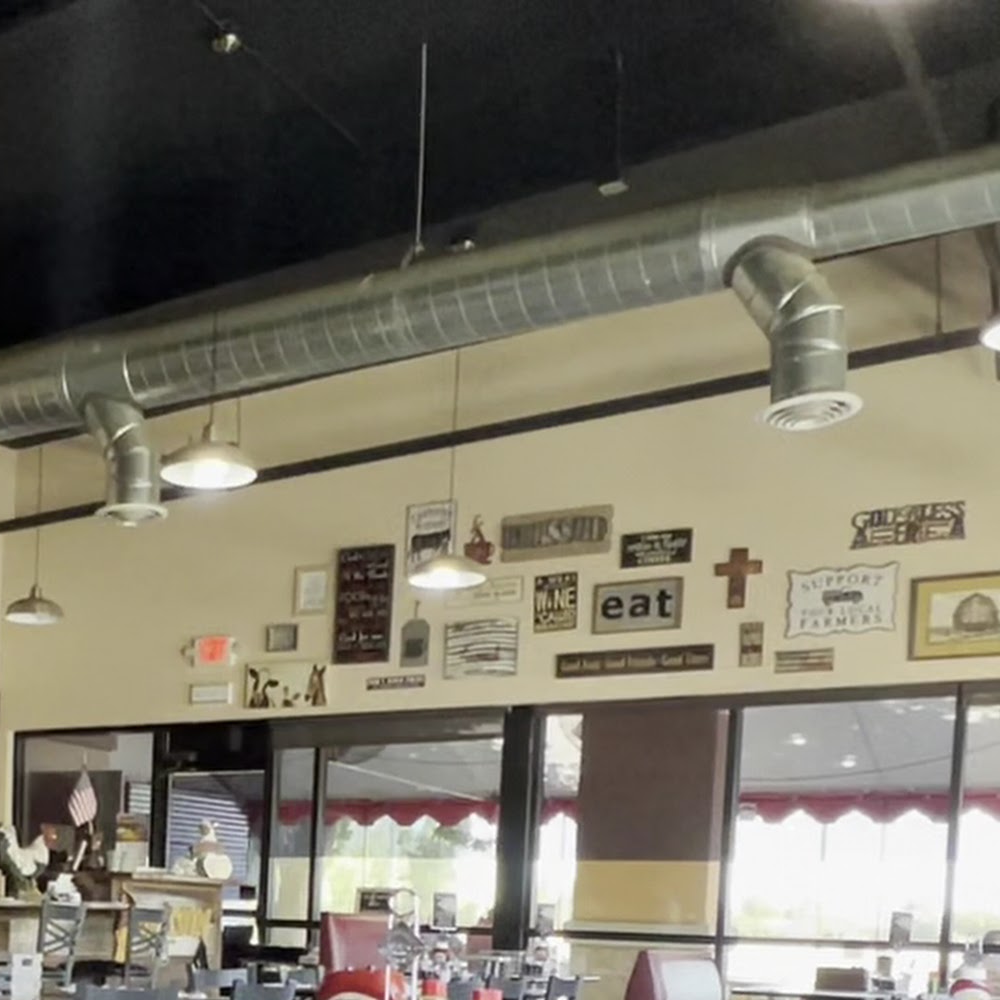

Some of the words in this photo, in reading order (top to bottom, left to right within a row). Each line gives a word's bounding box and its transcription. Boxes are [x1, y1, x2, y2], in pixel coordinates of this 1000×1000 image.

[800, 574, 883, 591] SUPPORT
[601, 588, 673, 620] eat
[799, 614, 882, 630] FARMERS
